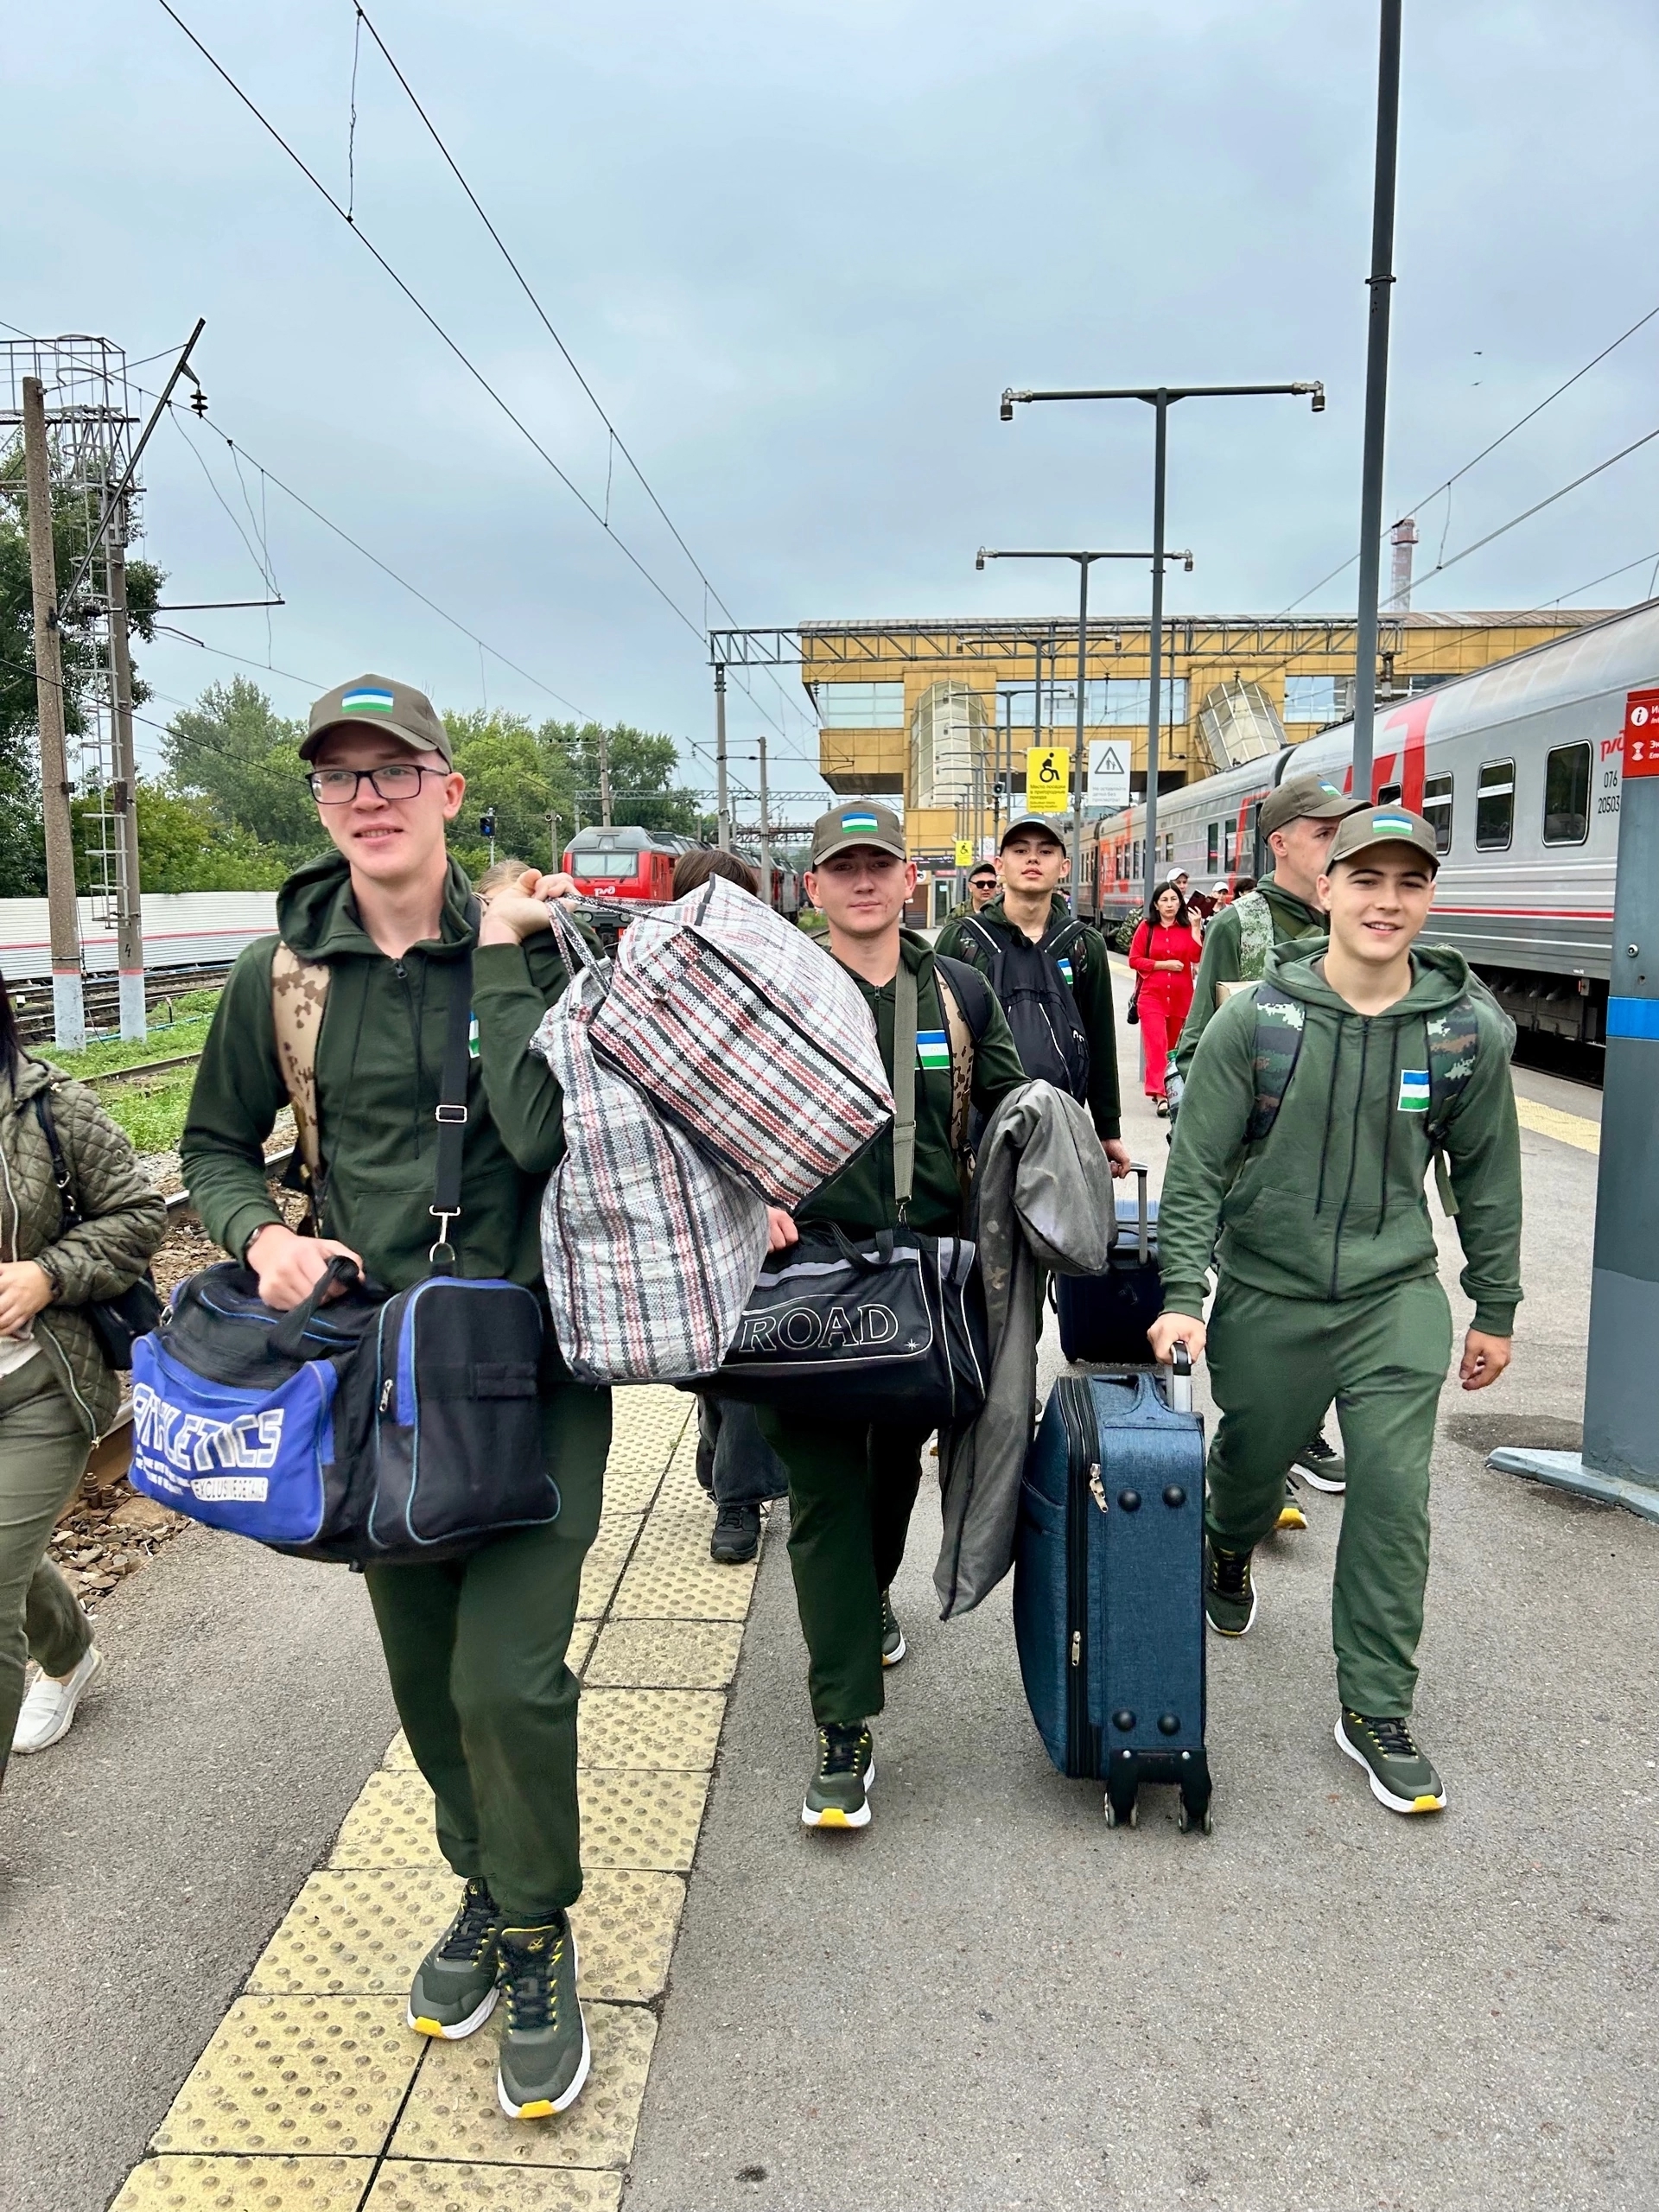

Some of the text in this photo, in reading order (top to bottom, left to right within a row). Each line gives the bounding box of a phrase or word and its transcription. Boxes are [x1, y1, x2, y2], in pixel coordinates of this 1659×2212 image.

[1604, 770, 1618, 788] 076
[1598, 795, 1620, 814] 20503
[739, 1303, 899, 1352] ROAD
